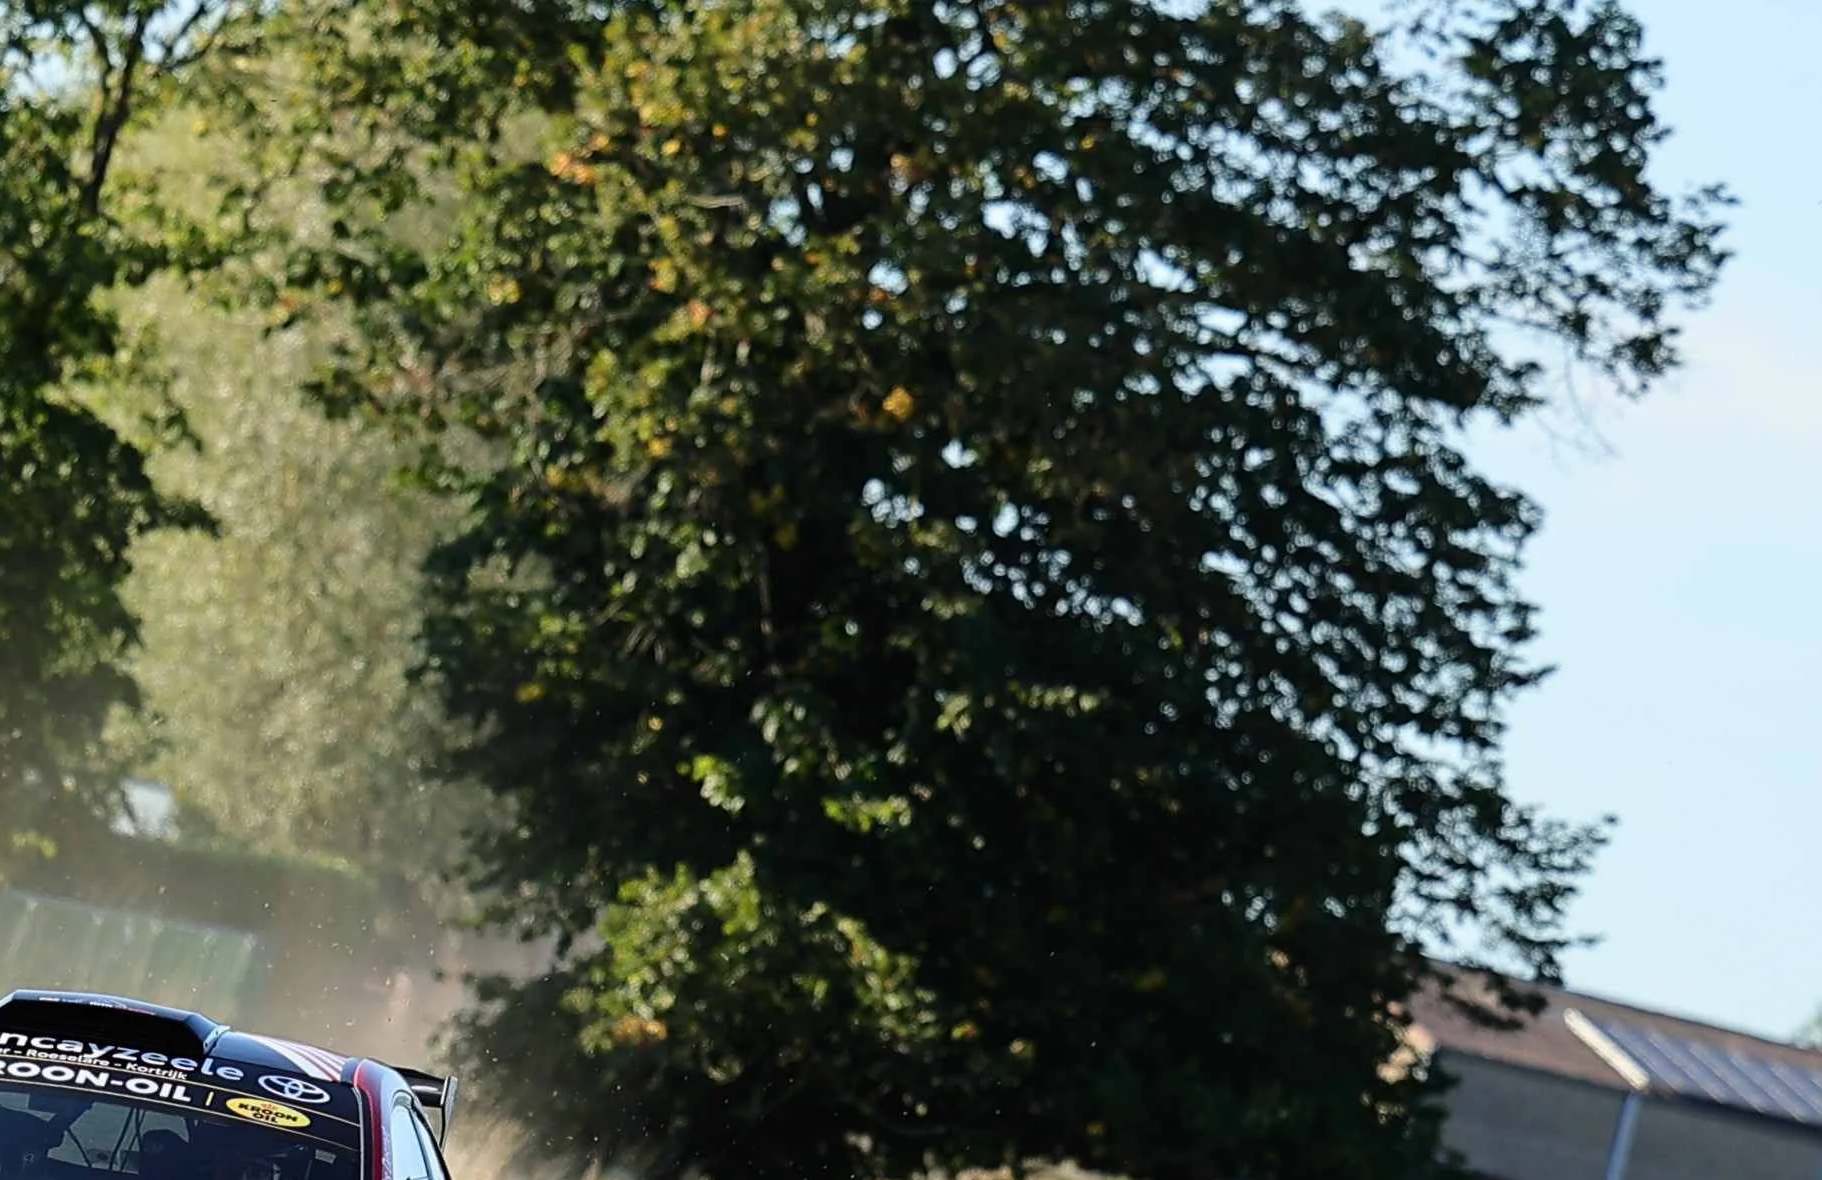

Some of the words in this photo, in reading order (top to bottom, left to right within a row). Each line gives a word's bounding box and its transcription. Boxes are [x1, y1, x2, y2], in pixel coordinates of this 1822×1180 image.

[126, 1062, 187, 1080] Kortrijk
[238, 1102, 298, 1123] KROON
[252, 1112, 279, 1123] OIL
